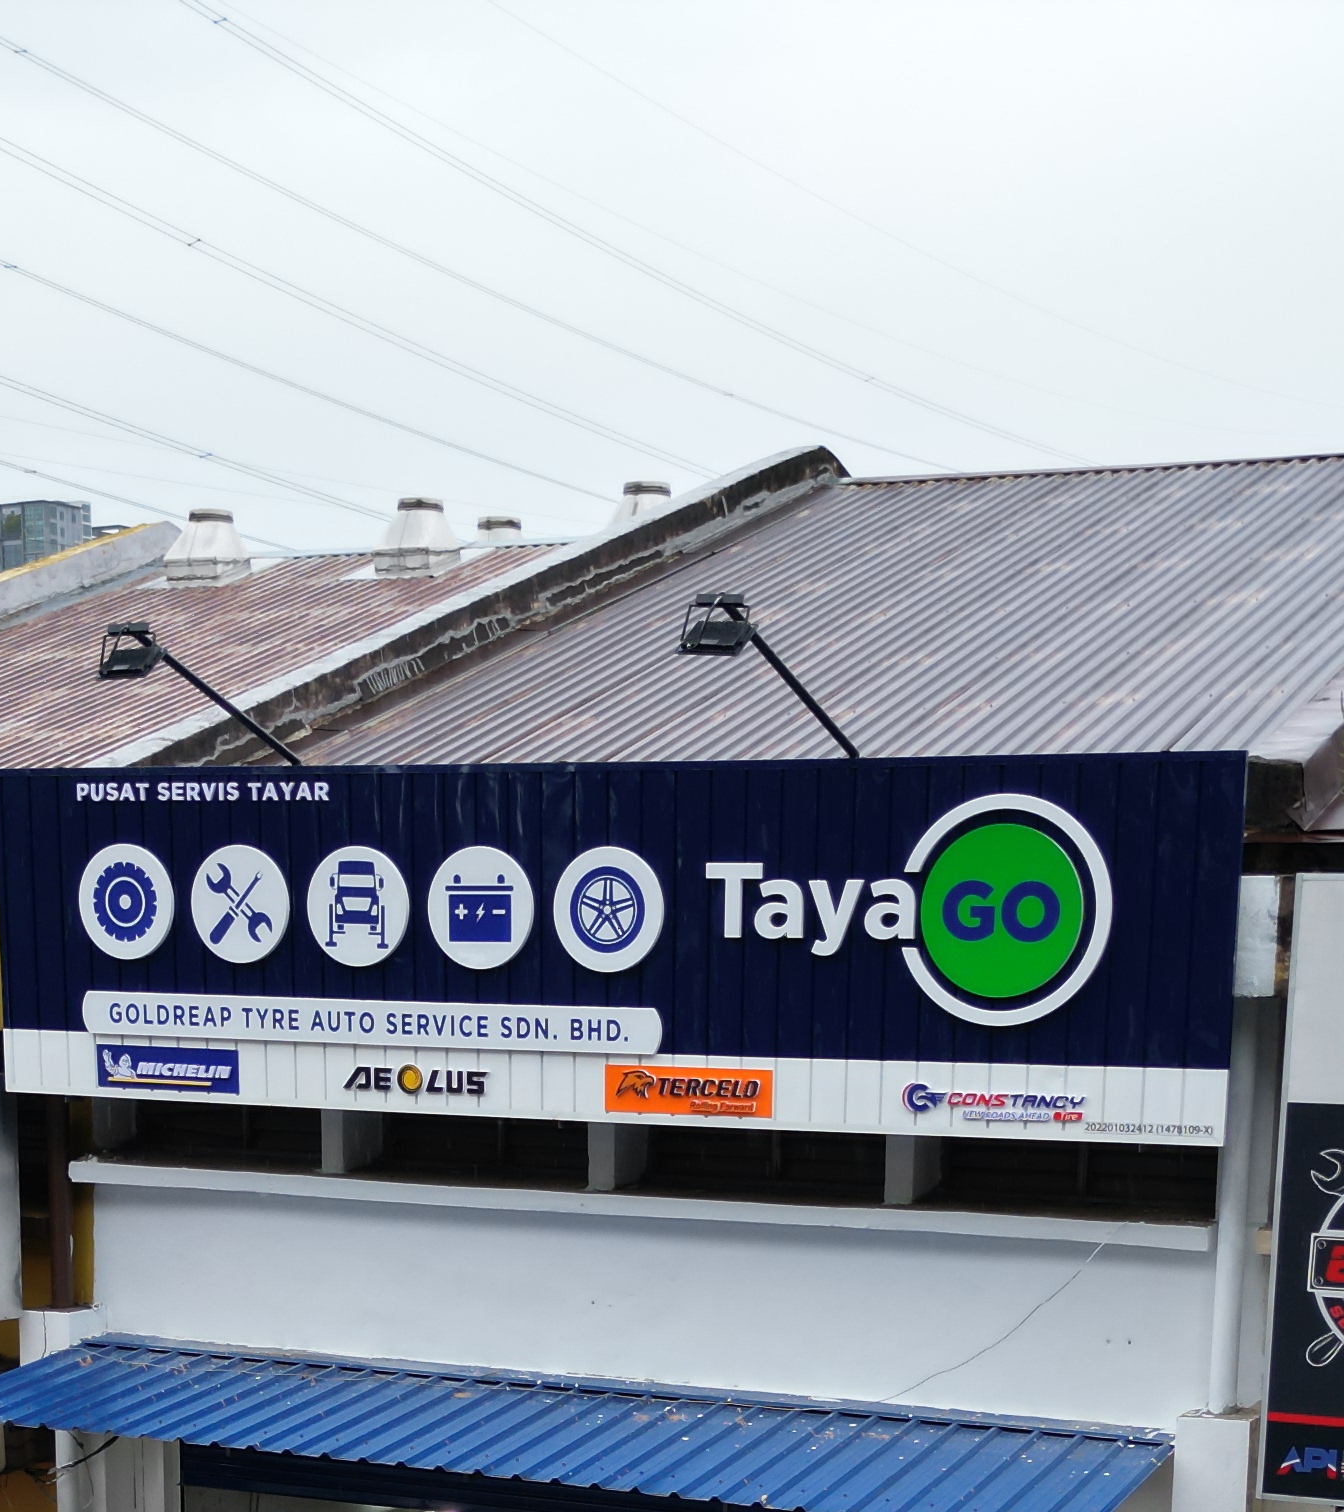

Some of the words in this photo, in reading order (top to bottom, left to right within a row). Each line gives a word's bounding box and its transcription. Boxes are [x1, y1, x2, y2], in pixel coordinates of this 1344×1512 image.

[76, 782, 150, 803] PUSAT
[156, 782, 241, 803] SERVIS
[246, 782, 330, 803] TAYAR
[705, 863, 916, 957] Taya
[941, 880, 1061, 943] GO
[108, 1001, 233, 1029] GOLDREAP
[242, 1007, 300, 1032] TYRE
[311, 1010, 375, 1035] AUTO
[385, 1012, 490, 1039] SERVICE
[500, 1016, 558, 1041] SDN.
[570, 1019, 629, 1043] BHD.
[136, 1060, 232, 1080] MICHELIN
[344, 1064, 489, 1096] AEOLUS
[658, 1077, 761, 1099] TERCELO
[720, 1102, 754, 1112] Forward
[947, 1092, 1086, 1109] CONSTANCY
[962, 1110, 984, 1119] NEW
[1018, 1111, 1050, 1121] AHEAD
[1277, 1446, 1337, 1480] API
